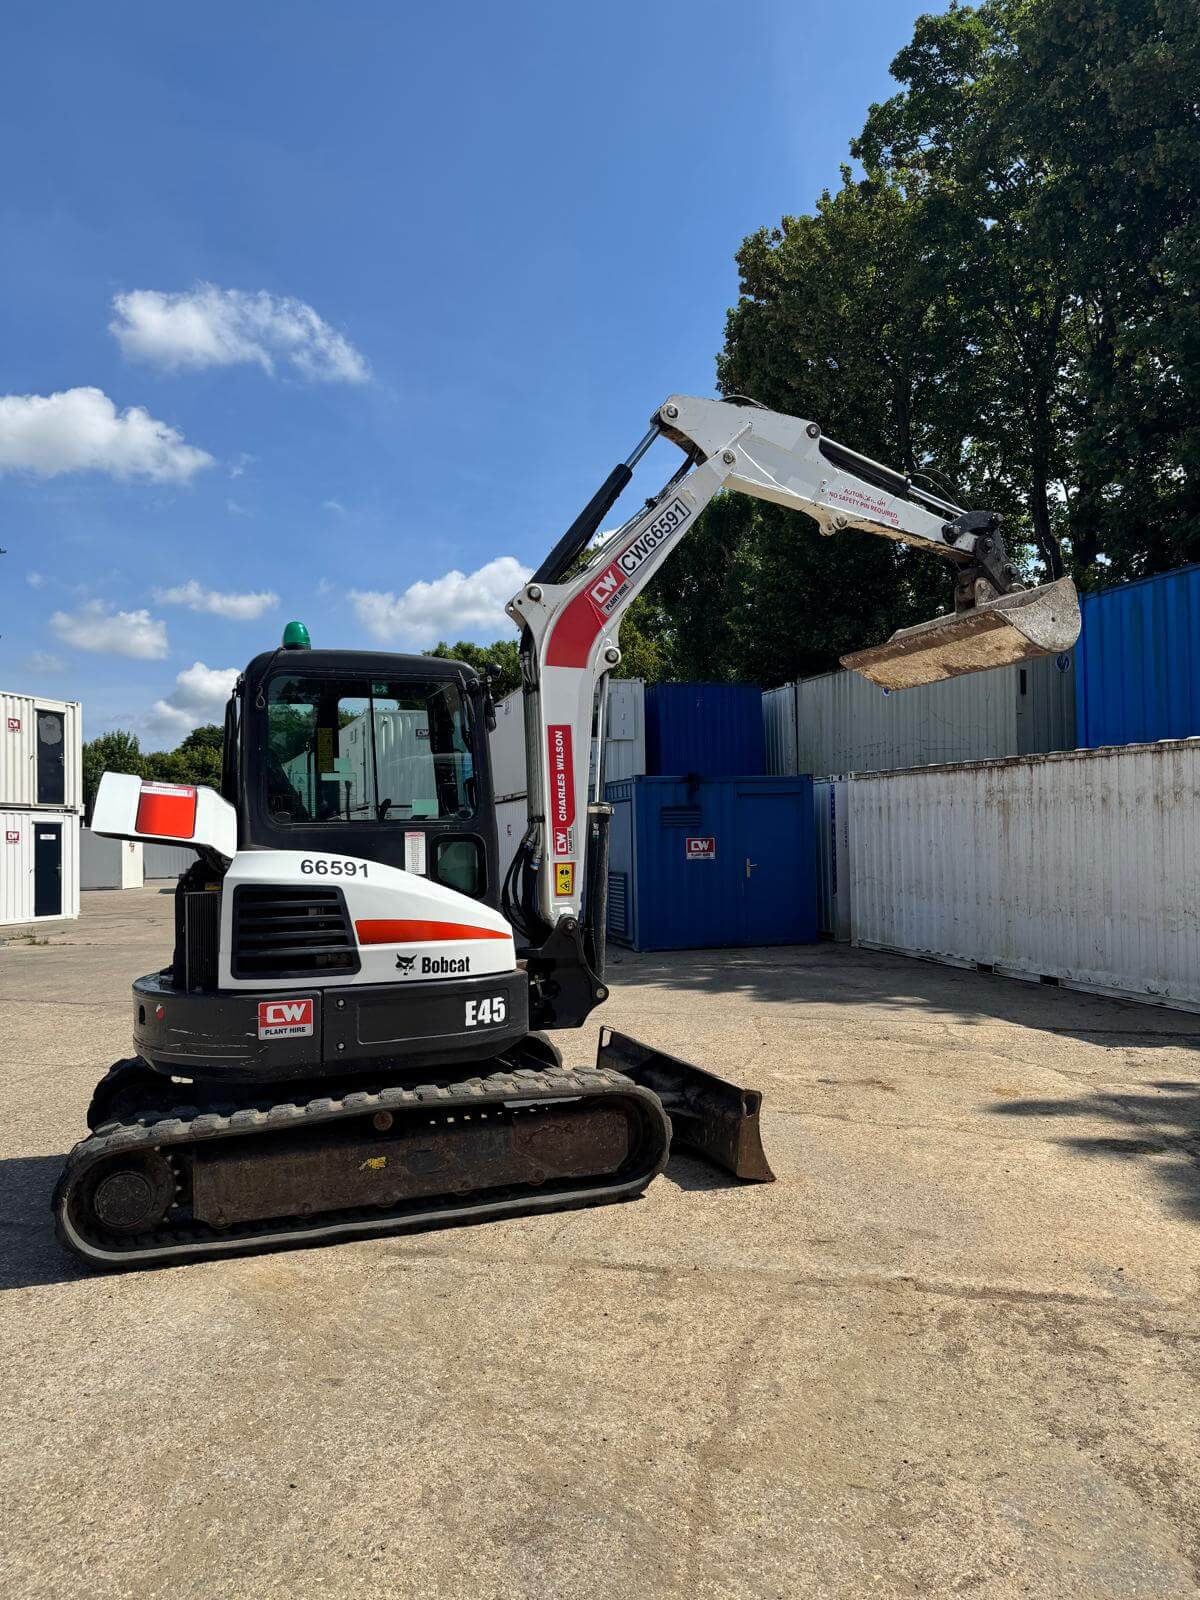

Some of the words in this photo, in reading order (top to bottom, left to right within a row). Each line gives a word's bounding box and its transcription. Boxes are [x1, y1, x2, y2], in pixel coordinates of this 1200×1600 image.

[870, 505, 898, 519] REQUIRED
[621, 503, 686, 572] CW66591
[591, 570, 618, 604] CW
[605, 593, 620, 611] PLANT
[555, 730, 565, 771] WILSON
[557, 773, 567, 821] CHARLES
[556, 831, 567, 853] CW
[691, 840, 710, 851] CW
[301, 859, 368, 878] 66591
[422, 956, 470, 974] Bobcat
[266, 1003, 306, 1023] CW
[465, 996, 506, 1027] E45
[265, 1028, 288, 1036] PLANT
[290, 1026, 306, 1034] HIRE
